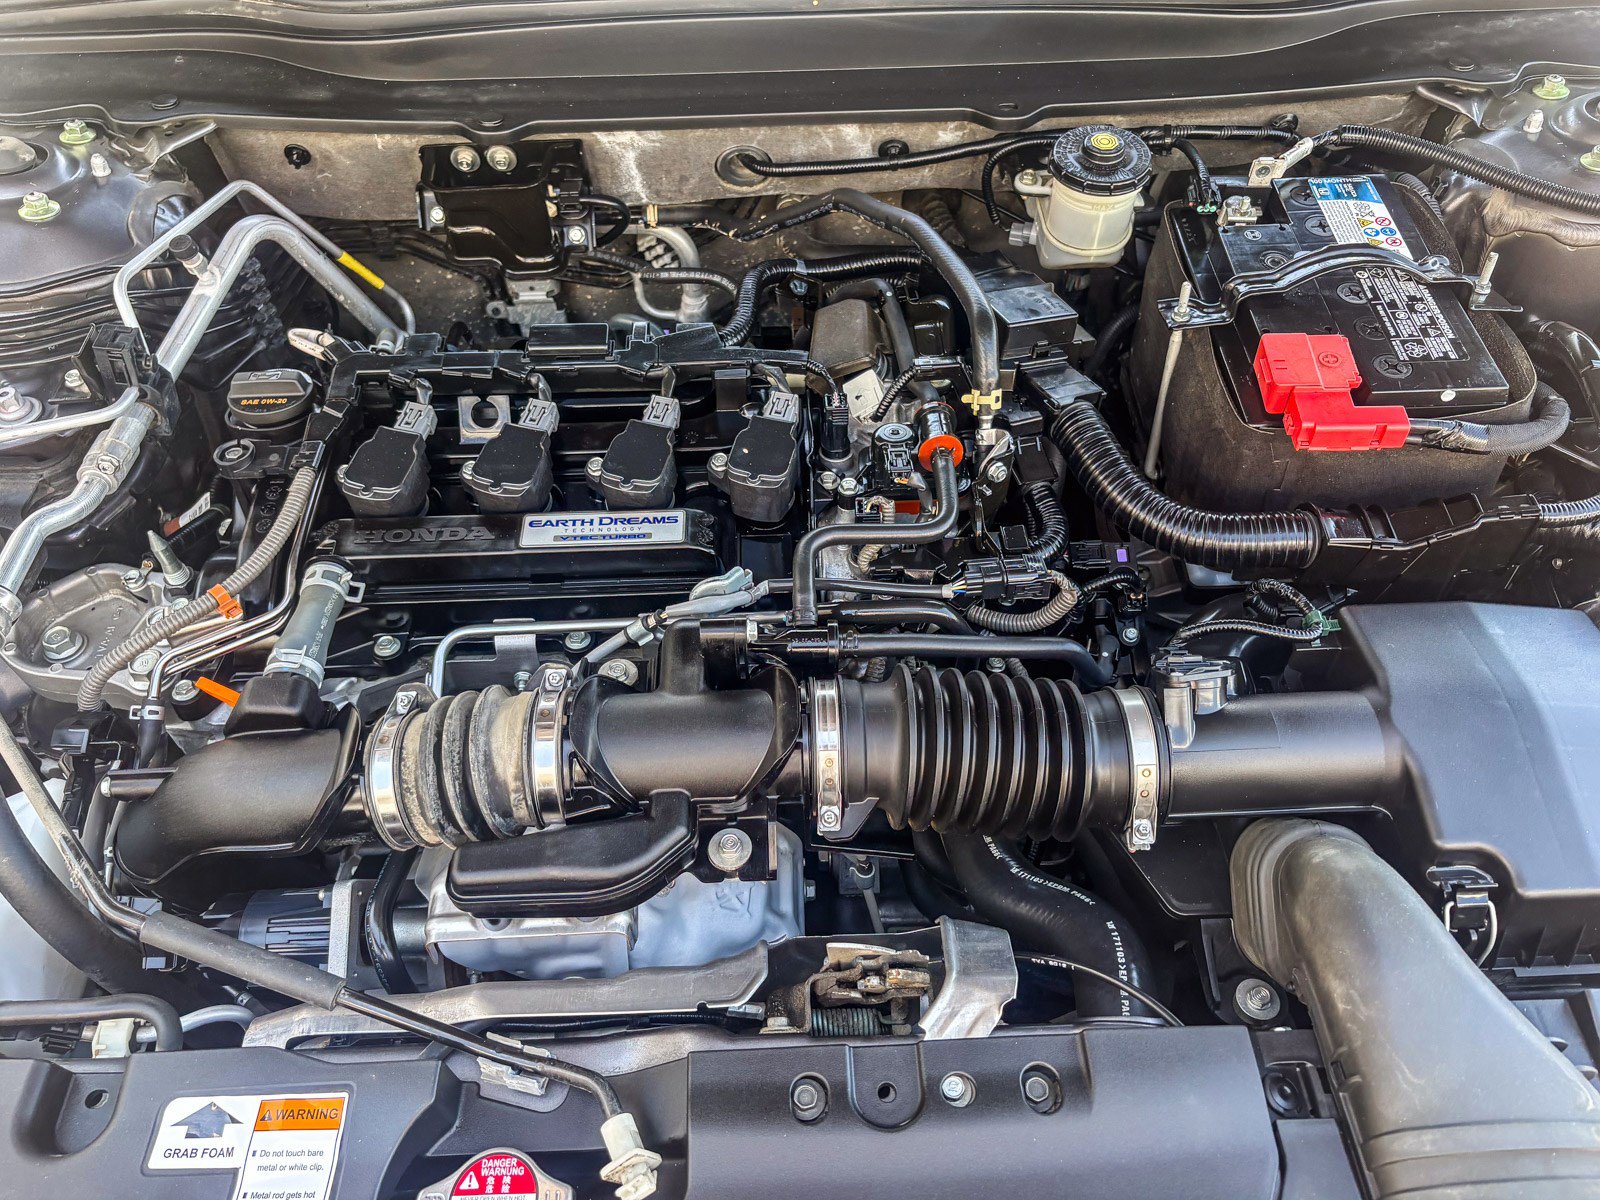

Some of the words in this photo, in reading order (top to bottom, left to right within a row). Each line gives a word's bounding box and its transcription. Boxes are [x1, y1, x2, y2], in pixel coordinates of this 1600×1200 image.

[528, 518, 594, 528] EARTH
[599, 515, 679, 526] DREAMS
[353, 526, 496, 545] HONDA
[275, 1108, 339, 1120] WARNING
[163, 1148, 198, 1159] GRAB
[200, 1146, 235, 1158] FOAM
[259, 1149, 271, 1157] Do
[285, 1149, 306, 1157] touch
[307, 1149, 324, 1157] bare
[288, 1163, 307, 1171] white
[309, 1162, 324, 1172] clip.
[481, 1157, 518, 1168] DANGER
[481, 1166, 525, 1177] WARNUNG
[250, 1191, 271, 1199] Metal
[272, 1191, 286, 1199] rod
[285, 1191, 302, 1200] gets
